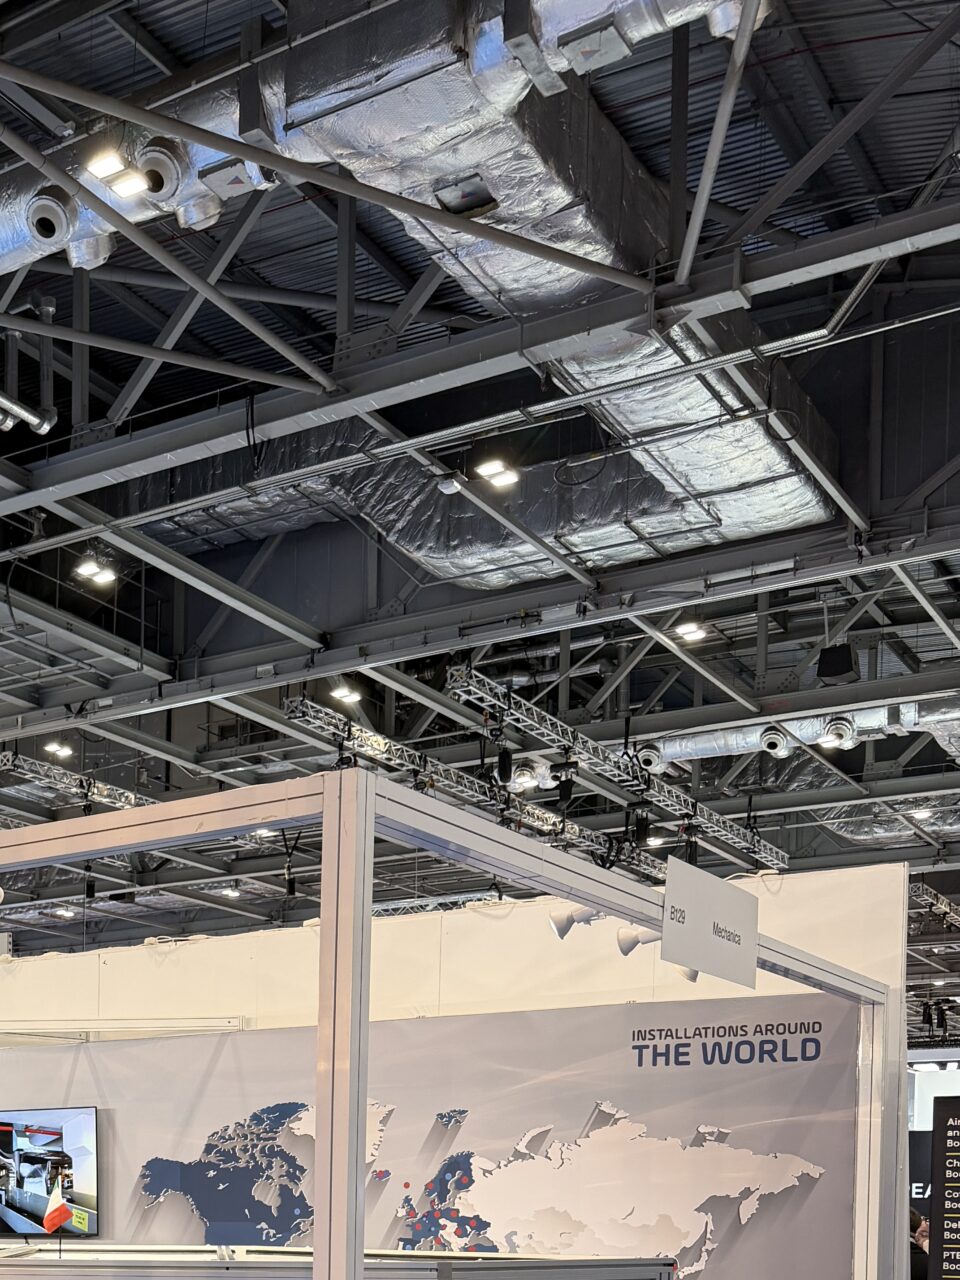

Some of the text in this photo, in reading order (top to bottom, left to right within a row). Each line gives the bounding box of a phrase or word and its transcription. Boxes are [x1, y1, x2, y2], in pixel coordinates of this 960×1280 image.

[670, 905, 742, 946] B129 Mechanica
[632, 1021, 822, 1042] INSTALLATIONS AROUND
[631, 1037, 822, 1067] THE WORLD
